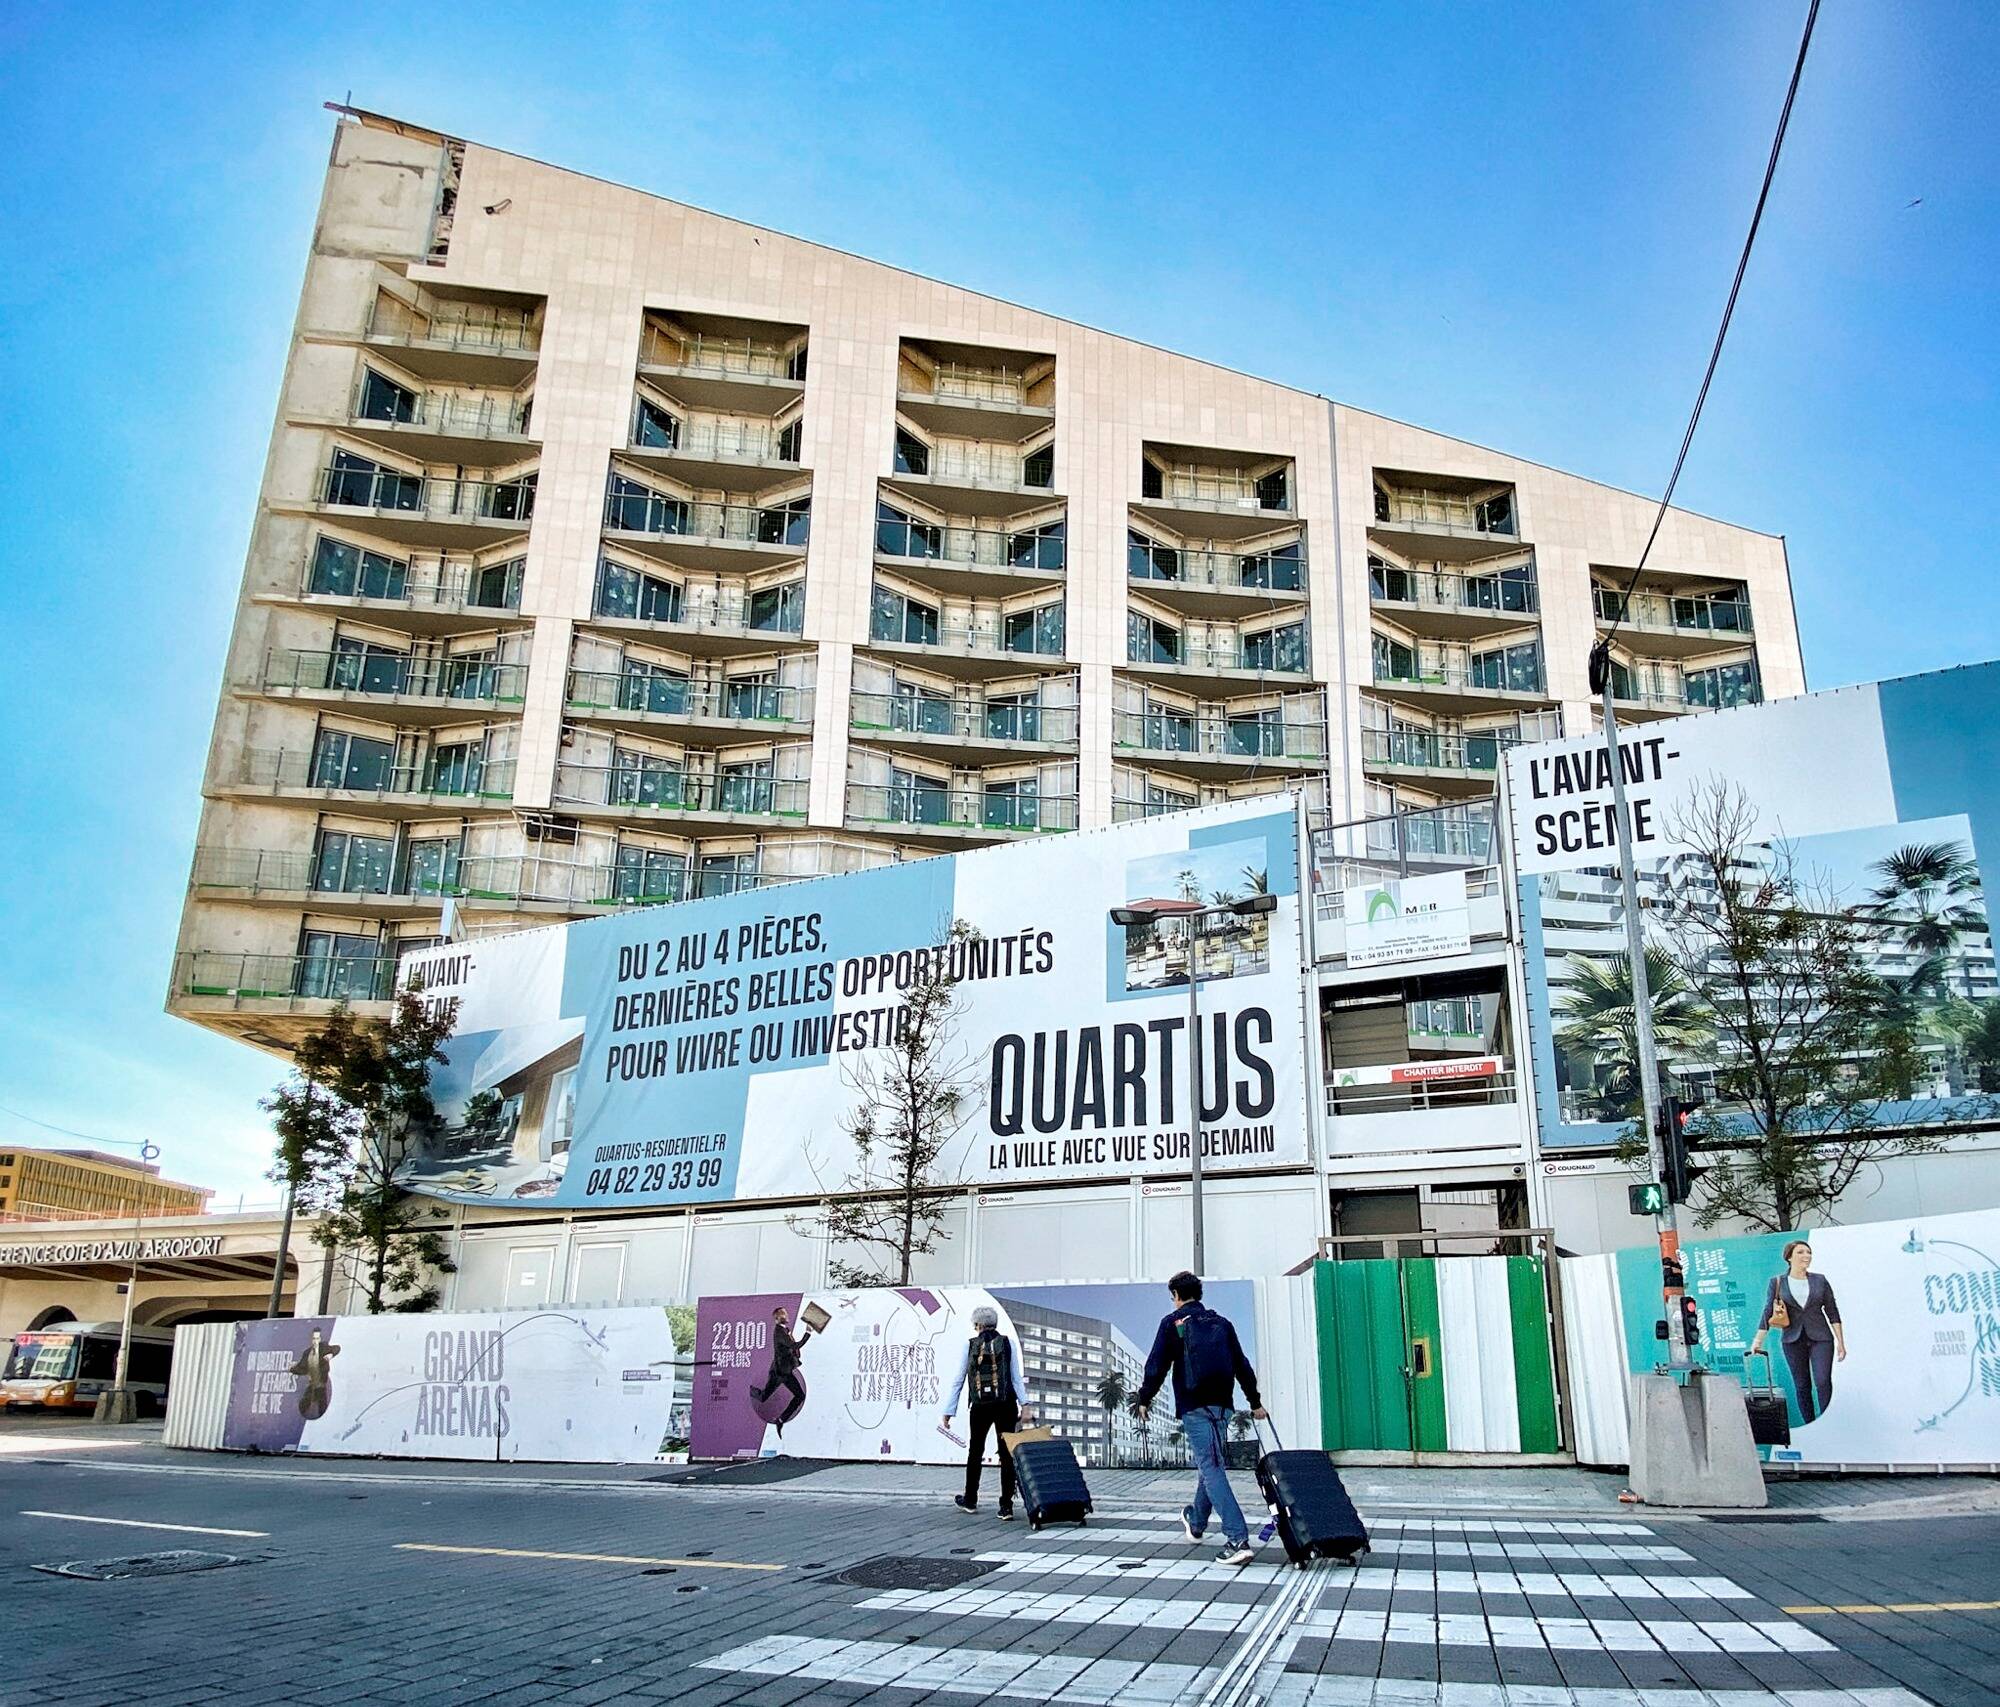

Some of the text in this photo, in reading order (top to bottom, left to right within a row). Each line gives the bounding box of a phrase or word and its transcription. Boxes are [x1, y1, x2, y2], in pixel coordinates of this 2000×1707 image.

[1530, 737, 1680, 799] L'AVANT-
[1535, 798, 1655, 856] SCÈNE
[618, 913, 829, 982] DU 2 AU 4 PIÈCES,
[407, 955, 476, 991] L'AVANT-
[612, 927, 1054, 1032] DERNIÈRES BELLES OPPORTUNITÉS
[606, 1004, 912, 1083] POUR VIVRE OU INVESTIR
[989, 1007, 1275, 1137] QUARTUS
[1403, 1063, 1484, 1077] CHANTIER INTERDIT
[594, 1133, 727, 1163] QUARTUS-RESIDENTIEL.FR
[989, 1125, 1275, 1169] LA VILLE AVEC VUE SUR DEMAIN
[586, 1157, 723, 1196] 04 82 29 33 99
[92, 1239, 141, 1259] D'AZUR
[145, 1236, 222, 1258] AEROPORT
[424, 1331, 504, 1382] GRAND
[712, 1320, 766, 1350] 22 000
[857, 1344, 936, 1375] QUARTIER
[414, 1385, 511, 1438] ARENAS
